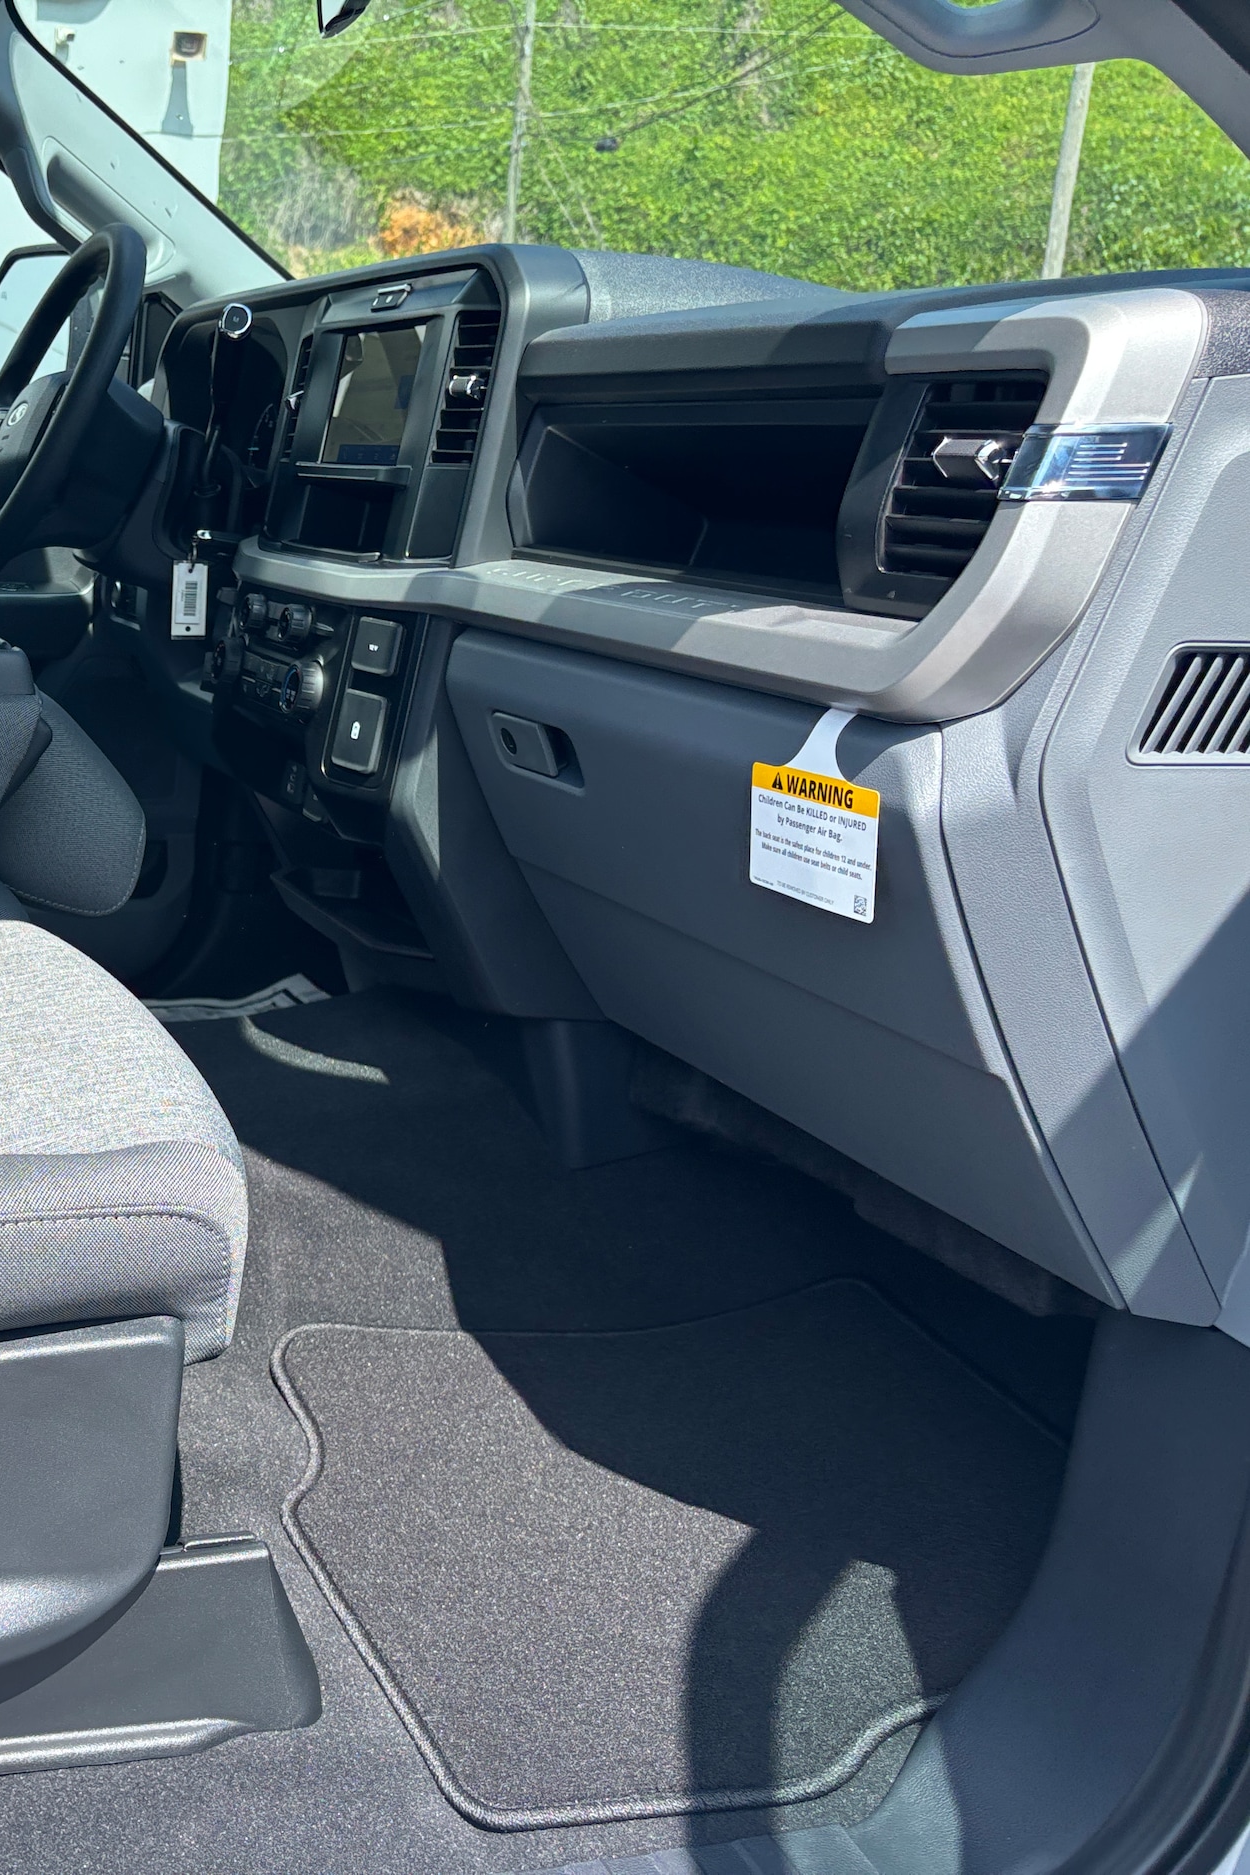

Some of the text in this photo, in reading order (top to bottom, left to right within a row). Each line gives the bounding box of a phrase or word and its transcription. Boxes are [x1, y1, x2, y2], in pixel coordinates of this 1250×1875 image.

[787, 774, 854, 809] WARNING
[758, 794, 867, 831] Children Can Be KILLED or INJURED
[777, 813, 843, 843] by Passenger Air Bag.
[761, 841, 772, 852] Make
[772, 846, 781, 855] sure
[787, 850, 802, 862] children
[810, 858, 819, 867] seat
[820, 861, 831, 871] belts
[837, 866, 849, 876] child
[762, 830, 771, 840] back
[791, 840, 803, 849] safest
[803, 844, 815, 855] place
[822, 849, 840, 861] children
[841, 854, 846, 863] 12
[847, 857, 856, 866] and
